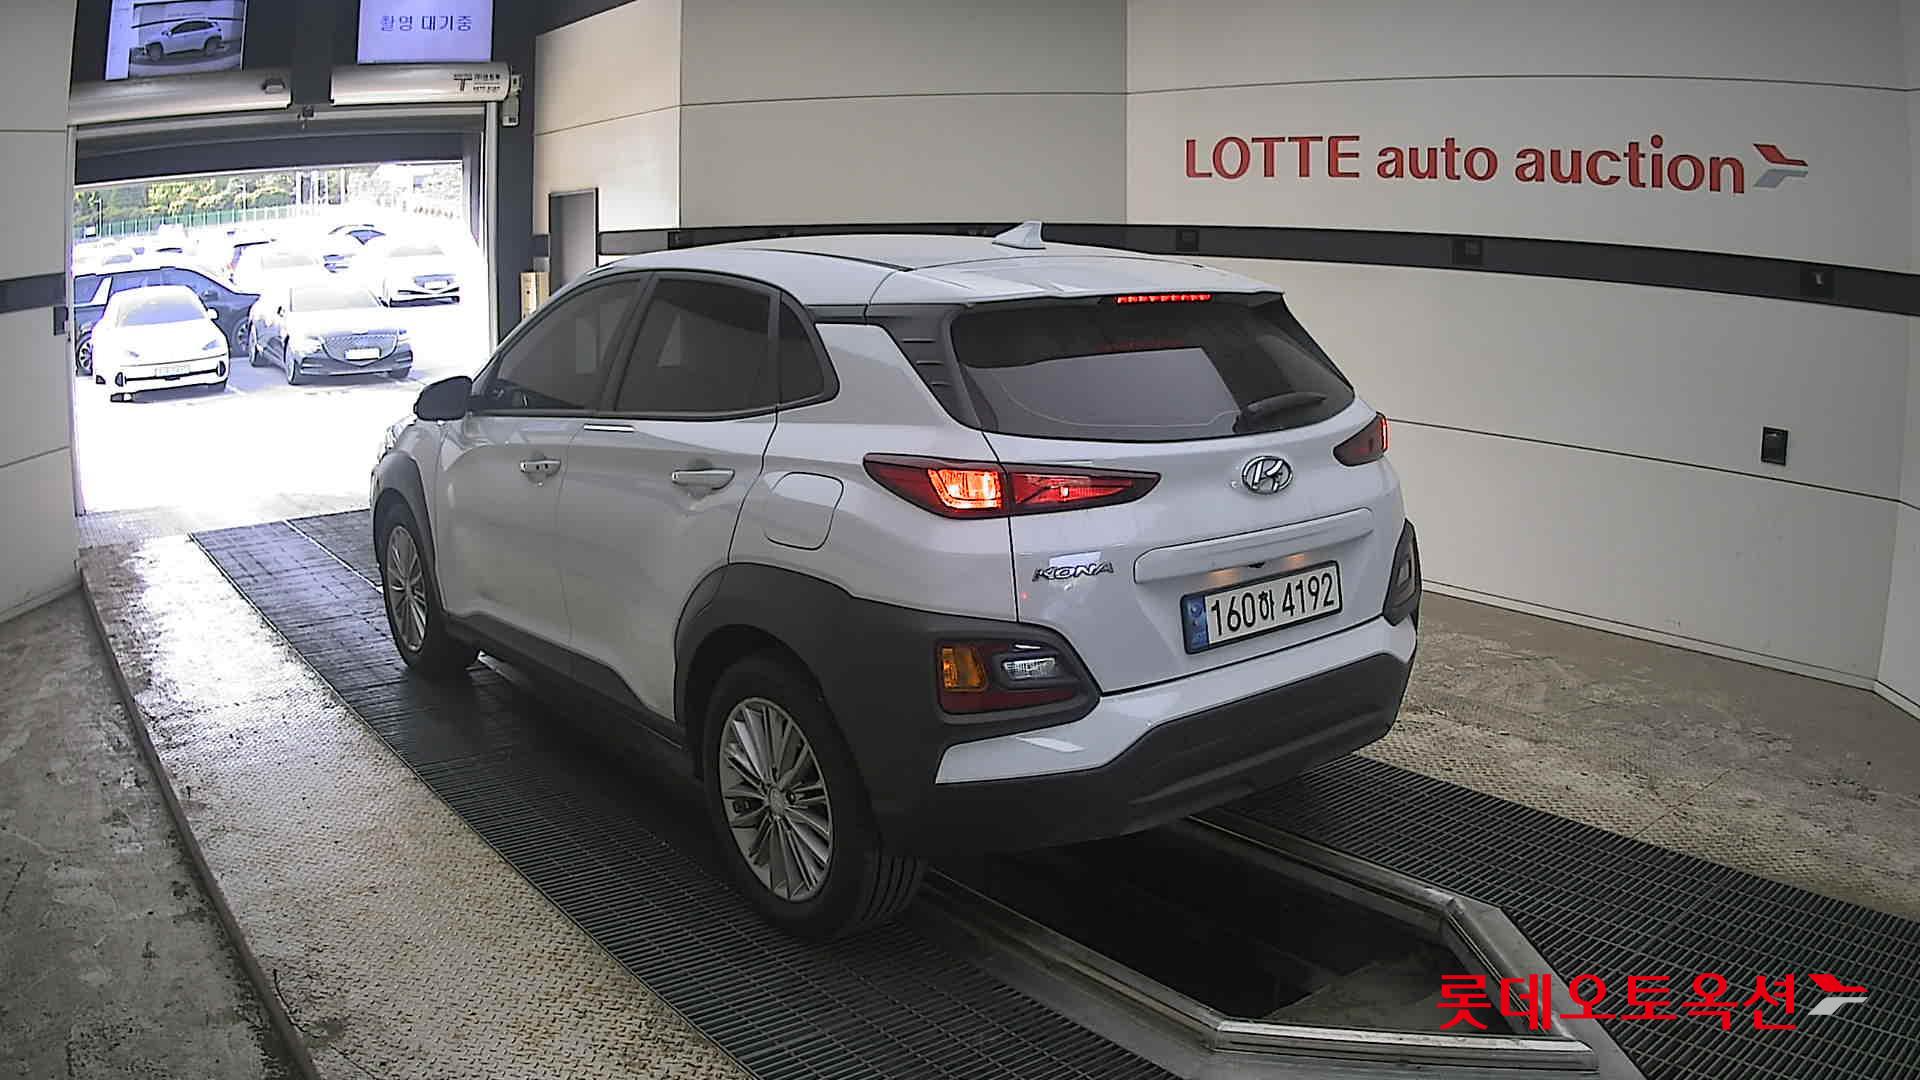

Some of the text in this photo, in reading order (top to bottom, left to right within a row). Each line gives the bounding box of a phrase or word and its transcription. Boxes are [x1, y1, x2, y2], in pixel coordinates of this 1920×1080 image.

[421, 15, 472, 32] 대기중
[1186, 134, 1744, 194] LOTTE auto auction
[1032, 560, 1114, 581] KONA
[1211, 572, 1335, 637] 160하 4192
